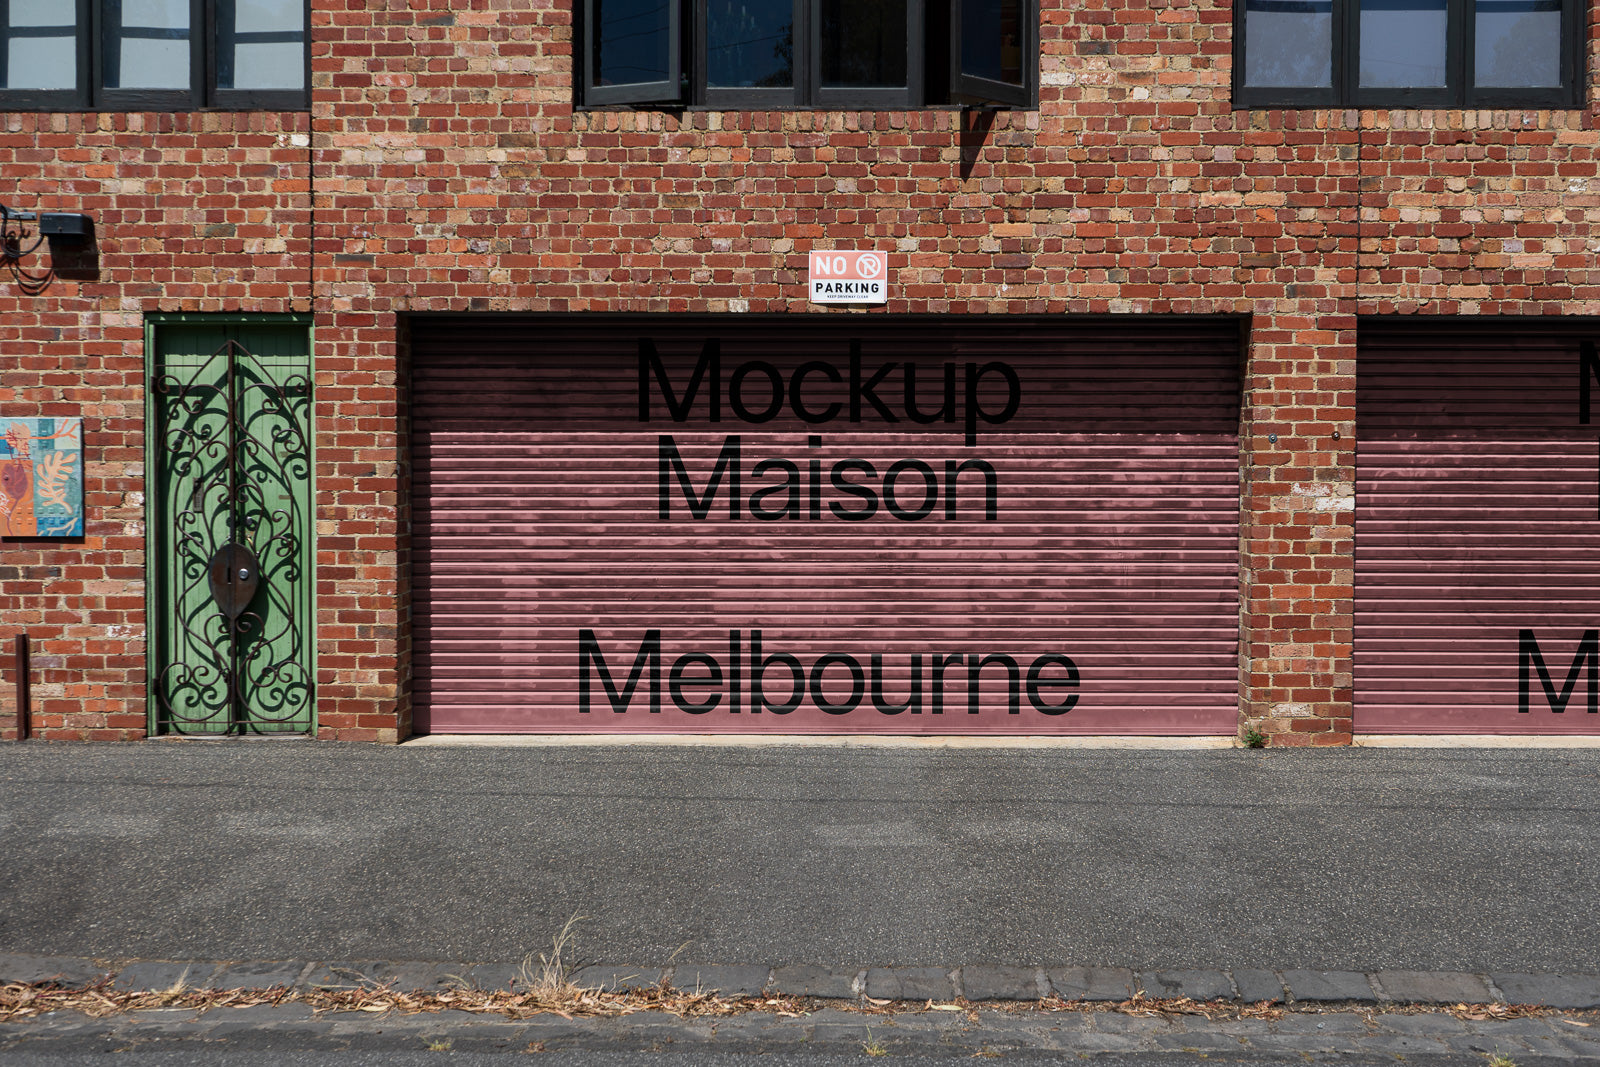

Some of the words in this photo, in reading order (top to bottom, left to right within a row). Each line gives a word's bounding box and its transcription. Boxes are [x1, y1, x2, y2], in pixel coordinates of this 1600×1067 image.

[815, 255, 847, 275] NO
[815, 282, 879, 293] PARKING
[638, 337, 1021, 447] Mockup
[658, 435, 998, 521] Maison
[578, 629, 1081, 716] Melbourne
